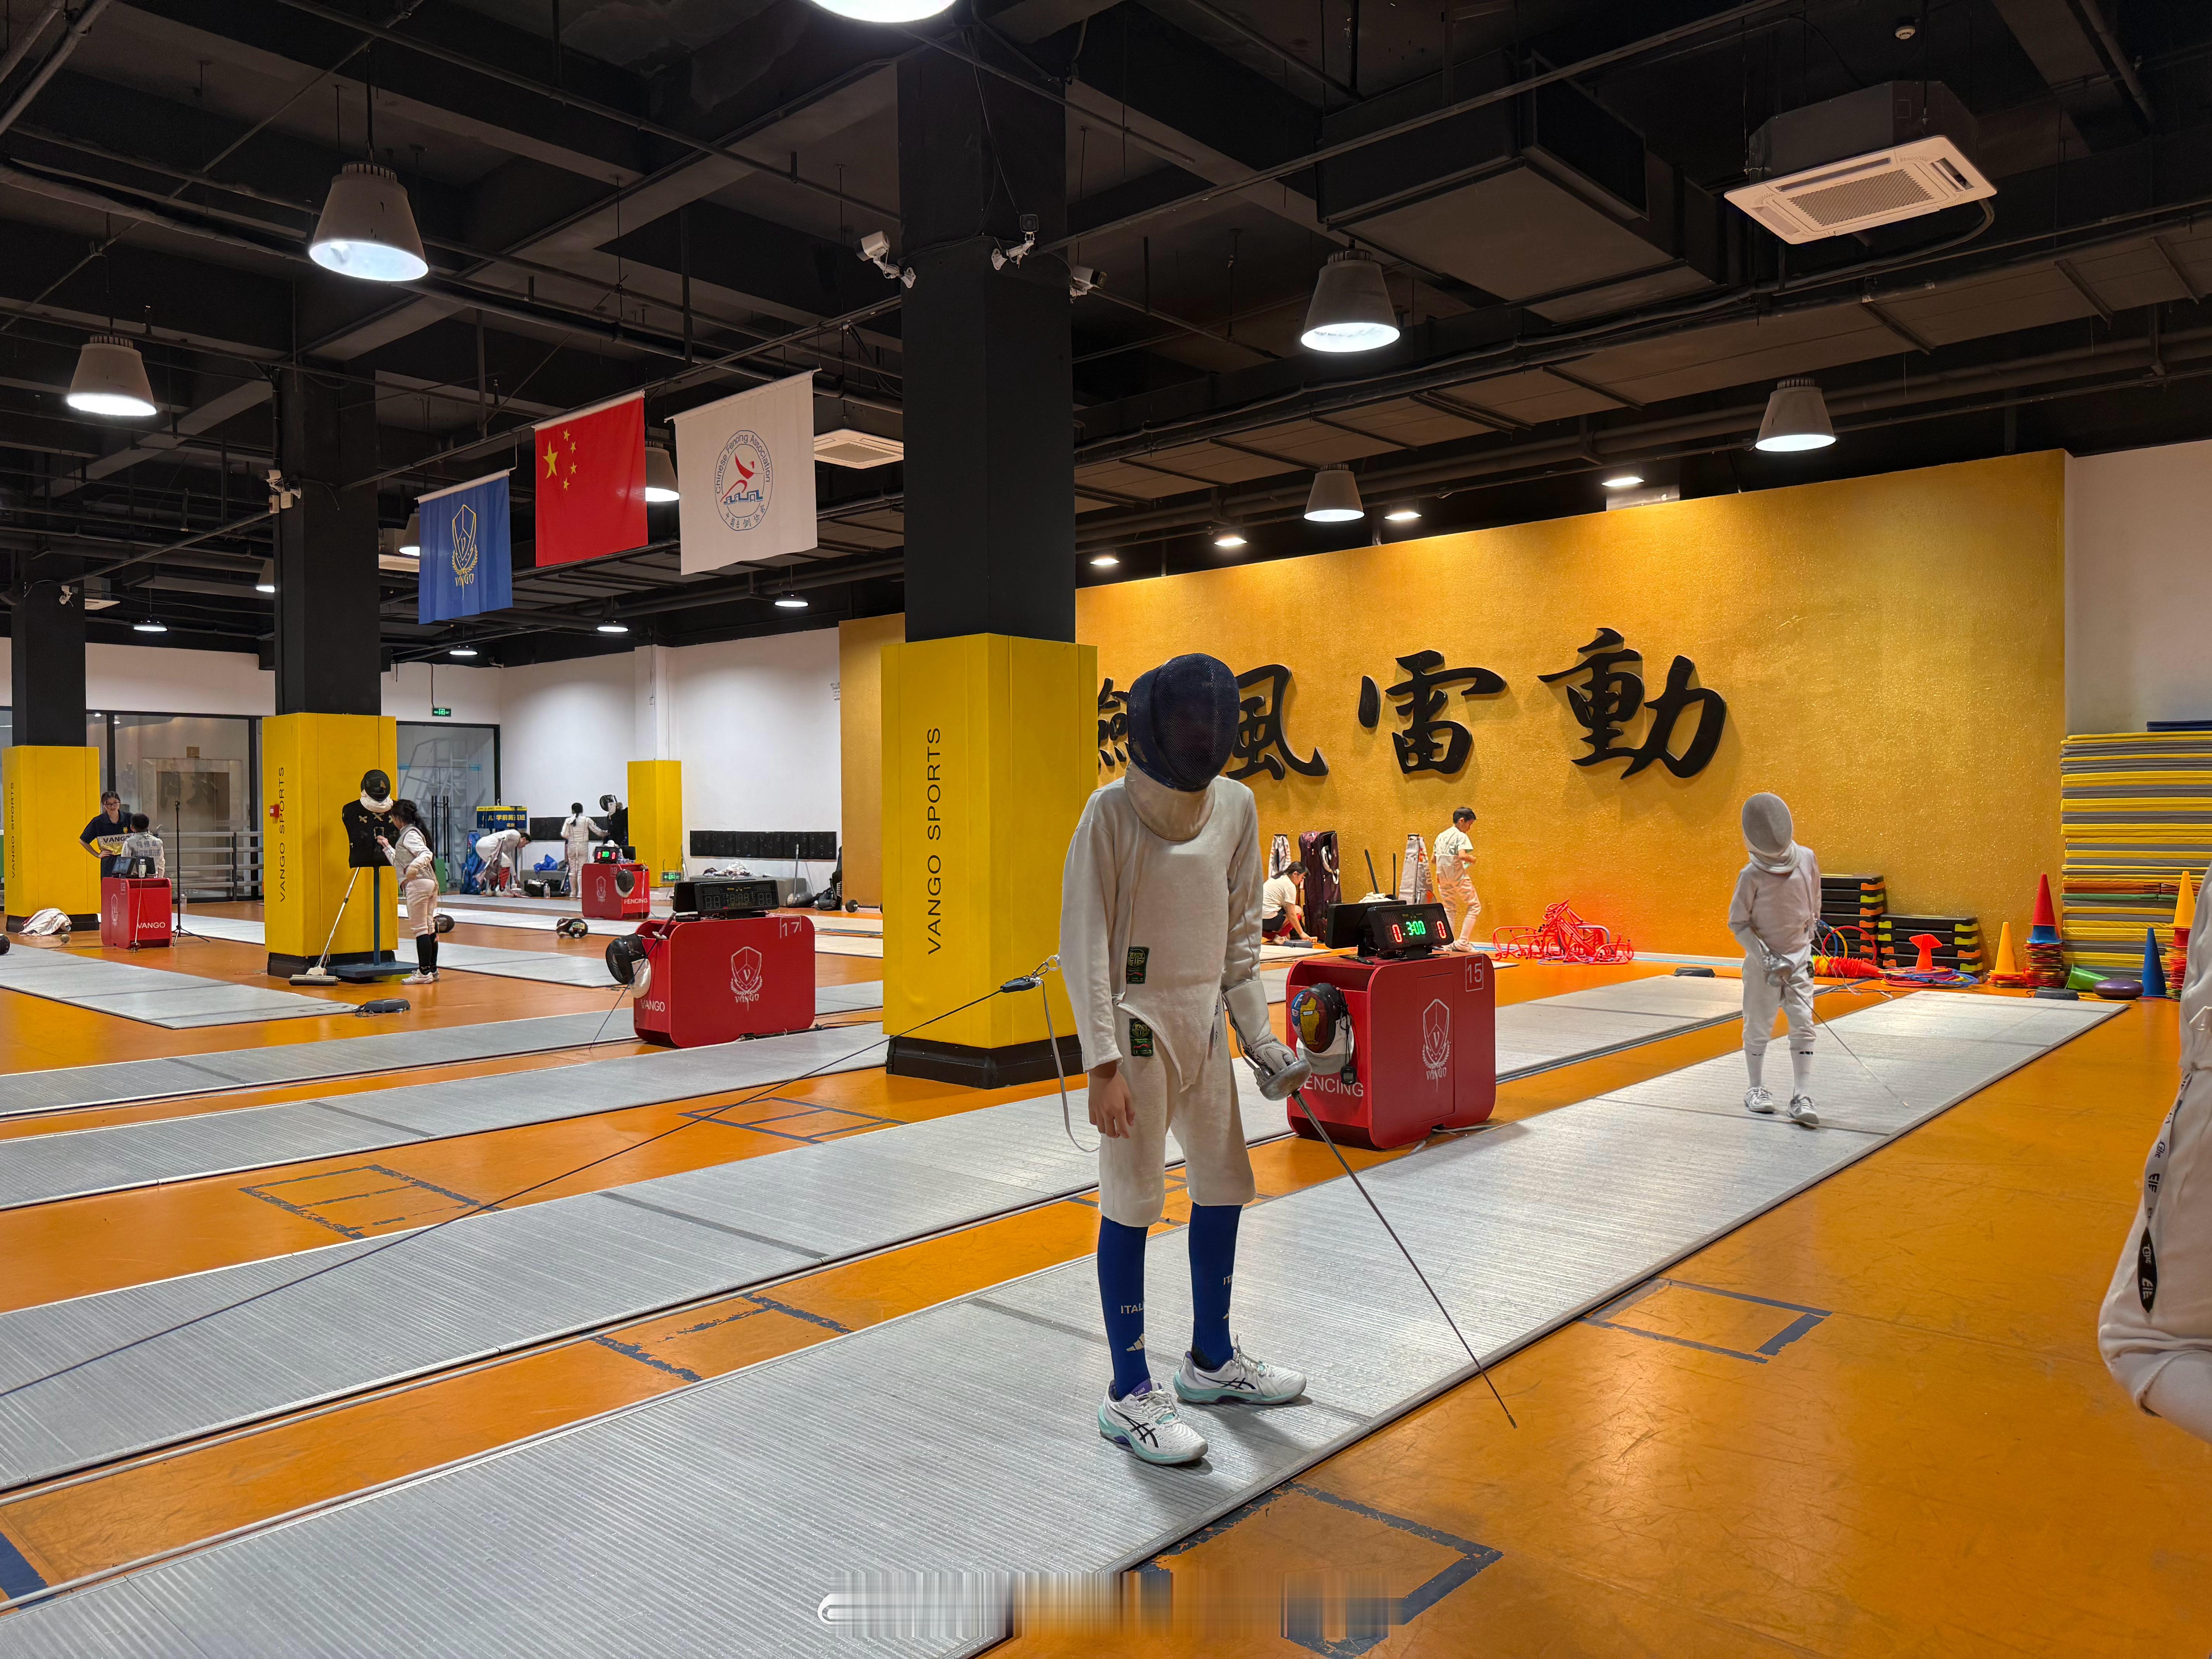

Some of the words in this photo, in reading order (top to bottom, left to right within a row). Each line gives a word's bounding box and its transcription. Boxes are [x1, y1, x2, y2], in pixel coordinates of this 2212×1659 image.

[716, 454, 728, 494] Chinese
[726, 434, 748, 454] Fencing
[750, 434, 771, 482] Association
[927, 728, 941, 840] SPORTS
[927, 855, 941, 955] VANGO
[782, 922, 800, 936] 17
[1392, 924, 1403, 943] 0
[1406, 921, 1426, 936] 3:00
[1436, 921, 1447, 939] 0
[1467, 963, 1482, 984] 15
[641, 999, 665, 1012] VANGO
[735, 994, 759, 1004] VANGO
[1426, 1067, 1447, 1080] VANGO
[1304, 1075, 1364, 1097] ENCING
